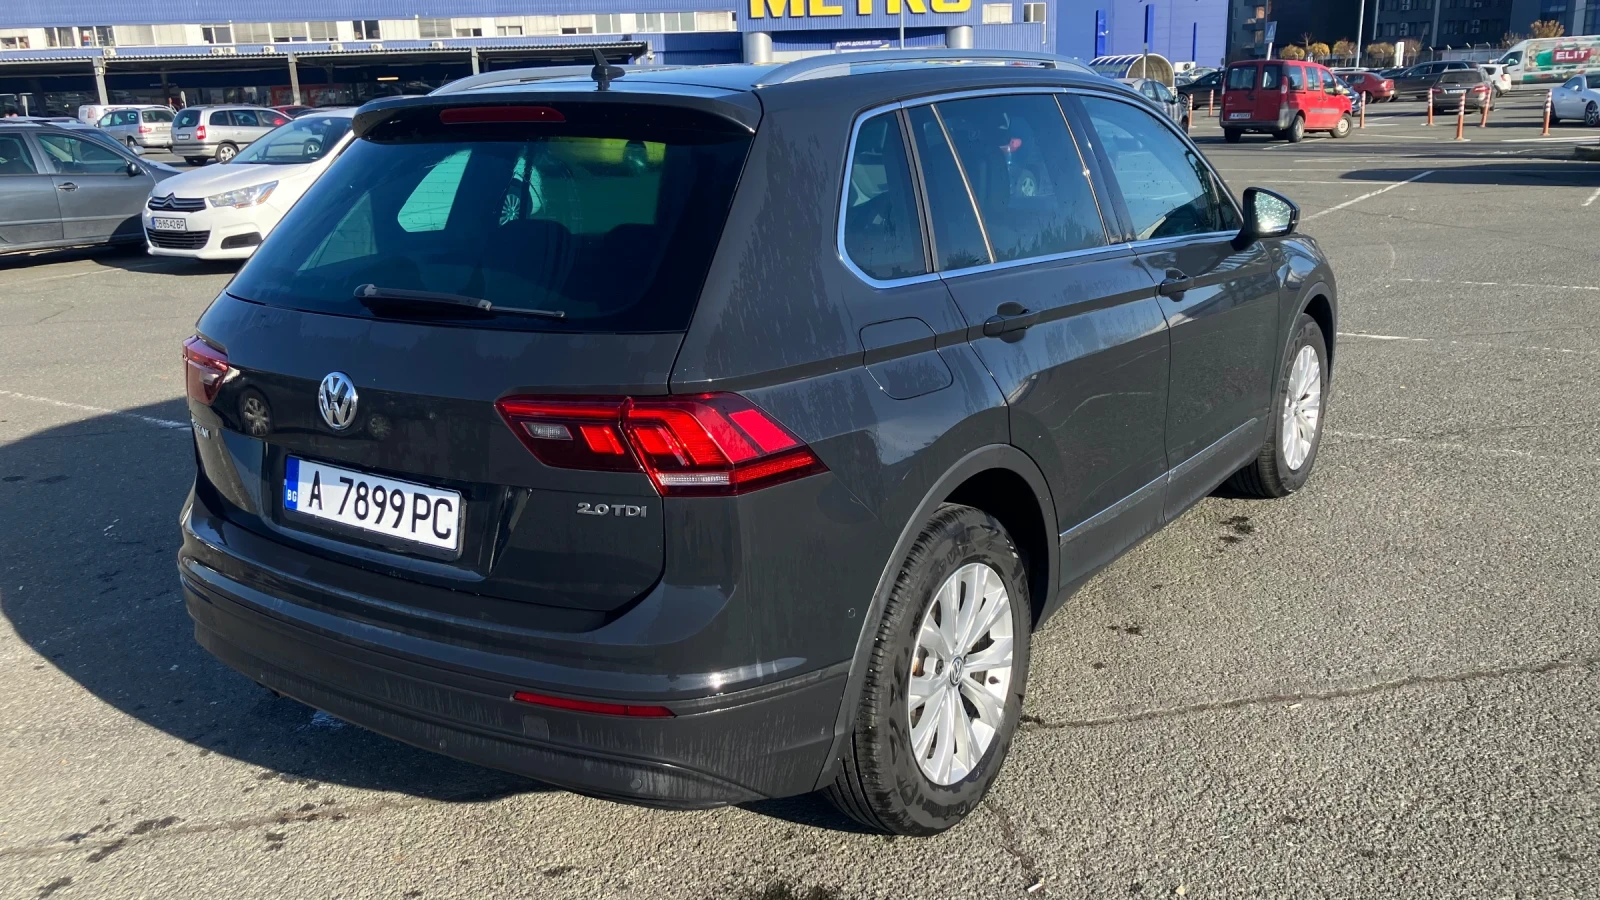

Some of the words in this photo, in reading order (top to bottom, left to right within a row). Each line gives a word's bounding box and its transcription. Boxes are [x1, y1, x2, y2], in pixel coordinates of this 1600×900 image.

[1556, 50, 1588, 60] ELIT
[287, 489, 297, 502] BG
[308, 470, 323, 511] A
[611, 504, 647, 518] TDI
